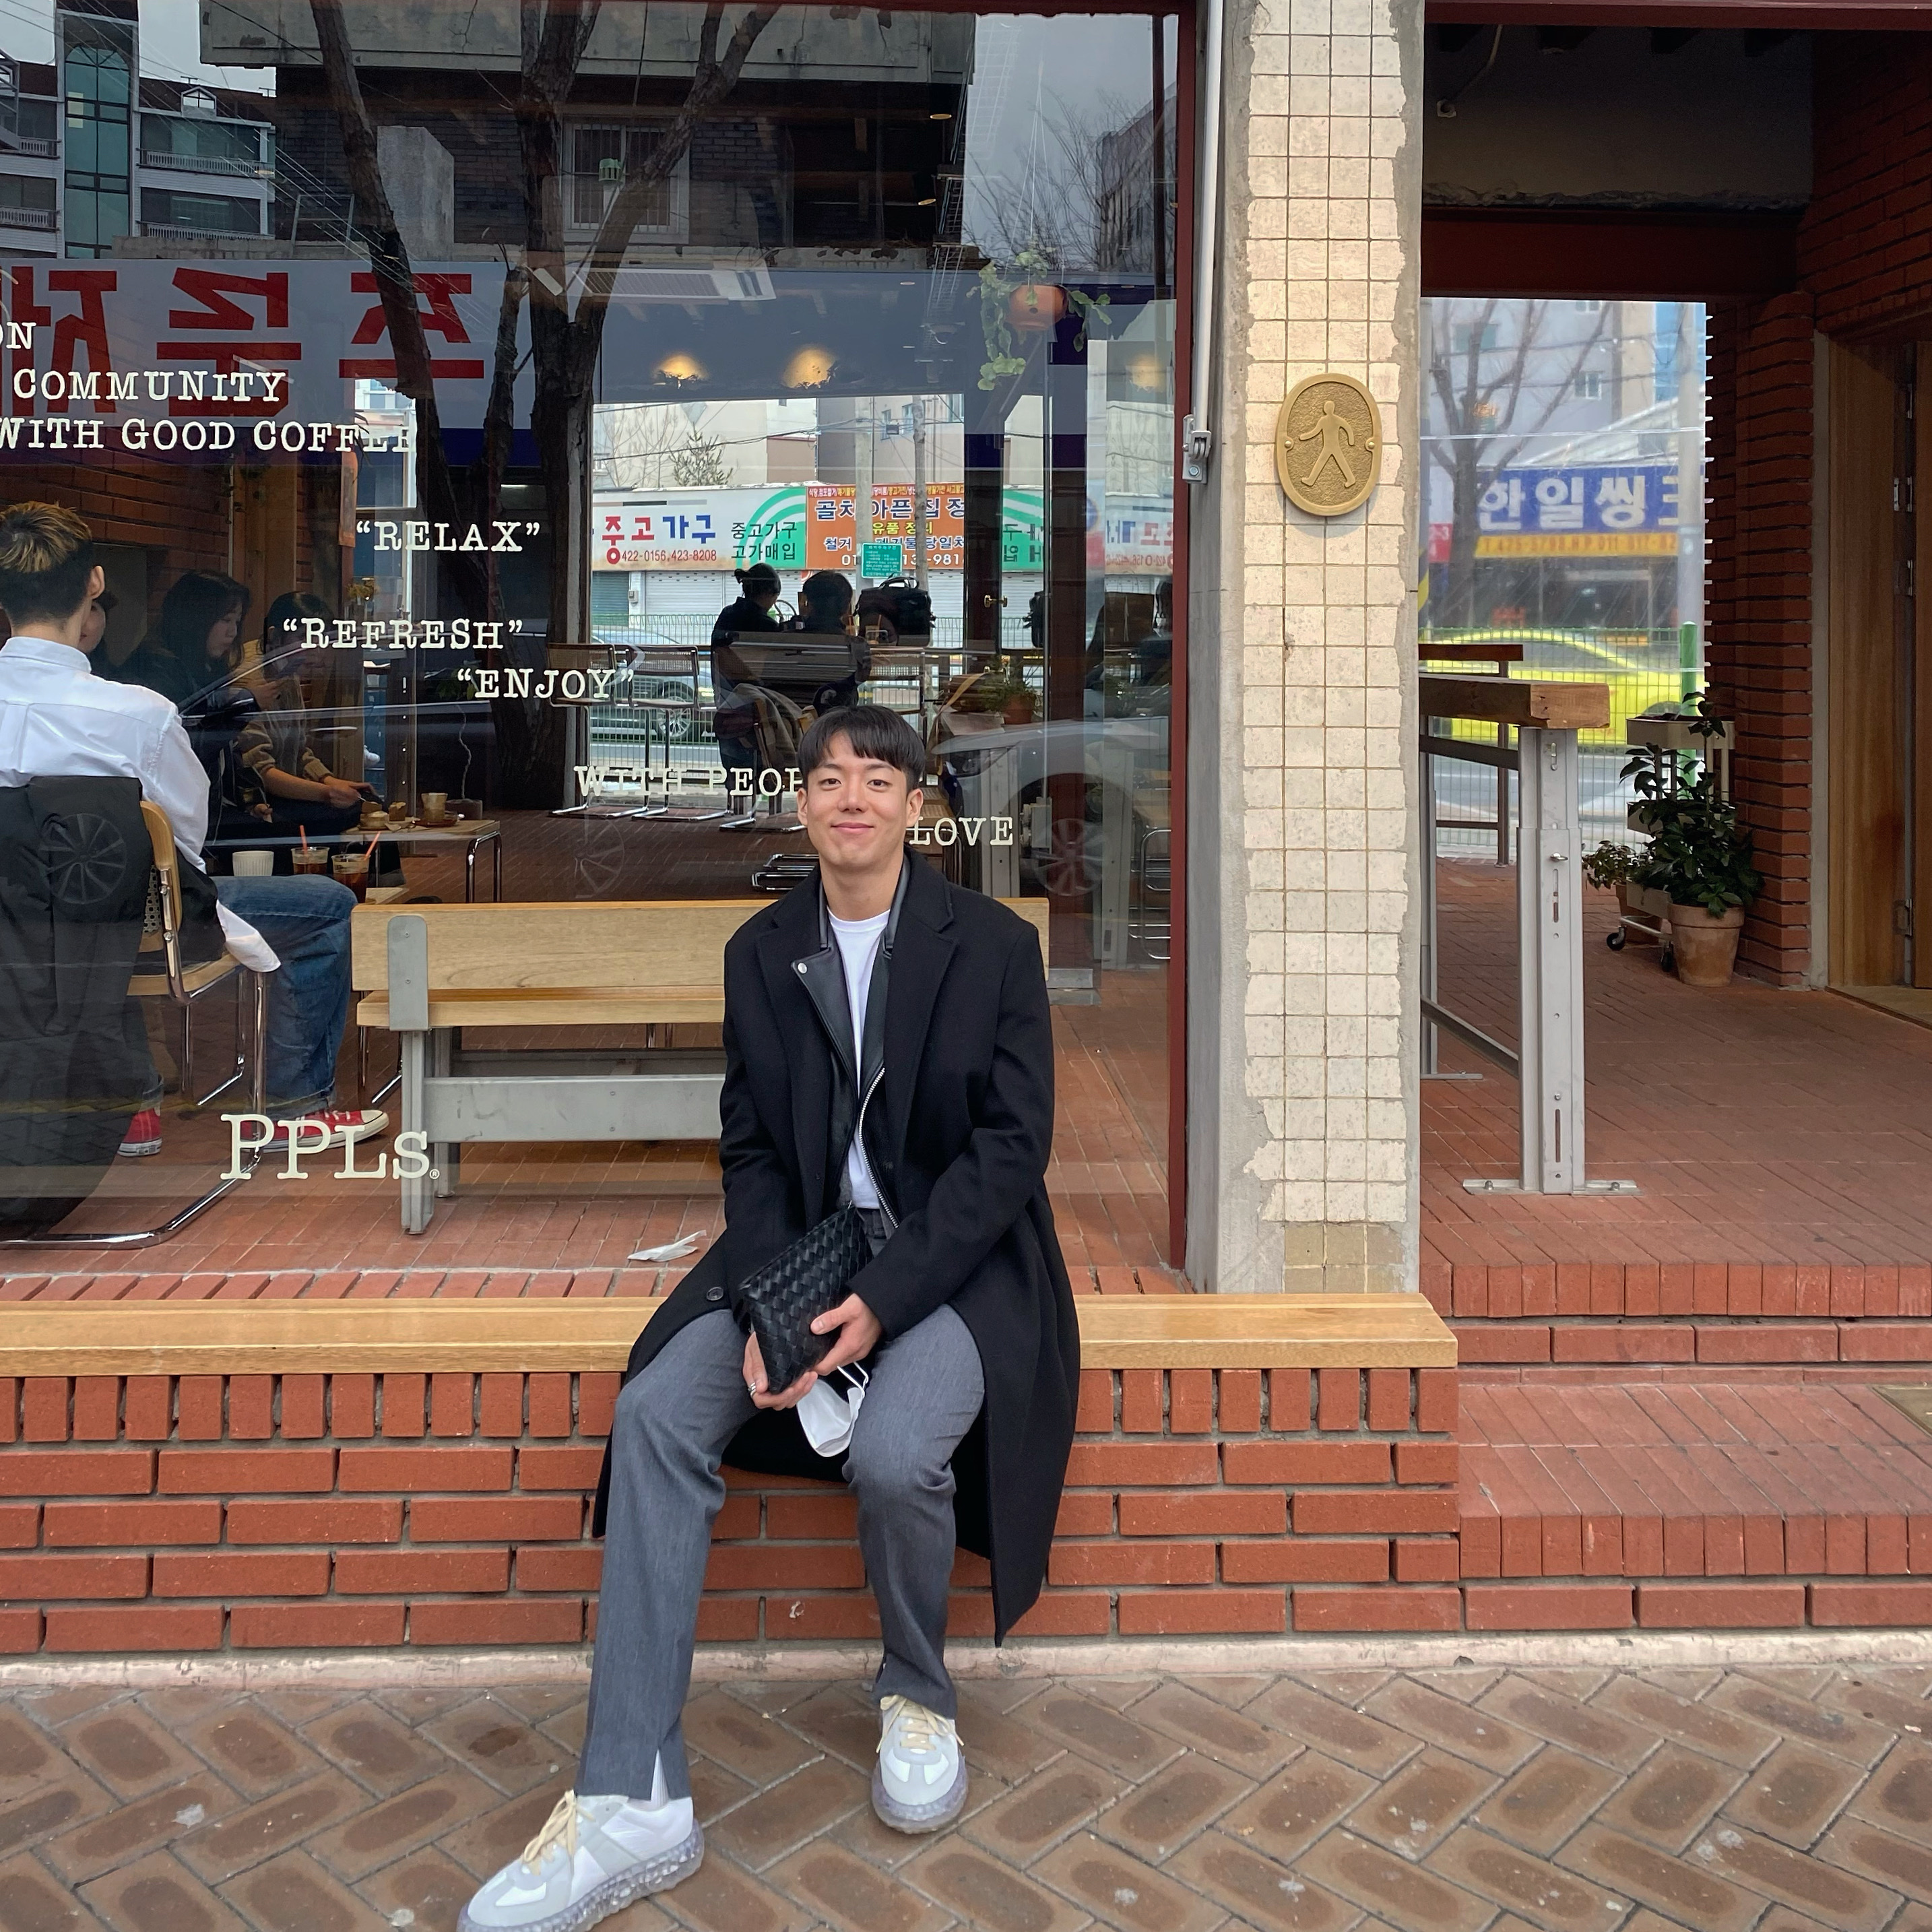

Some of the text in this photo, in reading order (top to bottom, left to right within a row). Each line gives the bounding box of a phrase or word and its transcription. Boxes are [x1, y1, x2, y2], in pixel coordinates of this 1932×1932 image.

[0, 321, 36, 350] N
[13, 368, 286, 402] COMMUNITY
[0, 417, 412, 453] WITH GOOD COFFEE
[356, 520, 540, 552] “RELAX”
[731, 521, 798, 540] 중고가구
[825, 536, 852, 550] 철거
[872, 521, 900, 536] 유품
[731, 542, 796, 560] 고가매입
[283, 618, 523, 649] “REFRESH”
[457, 668, 633, 699] “ENJOY”
[574, 765, 804, 796] WITH PEOP
[910, 816, 1013, 847] LOVE
